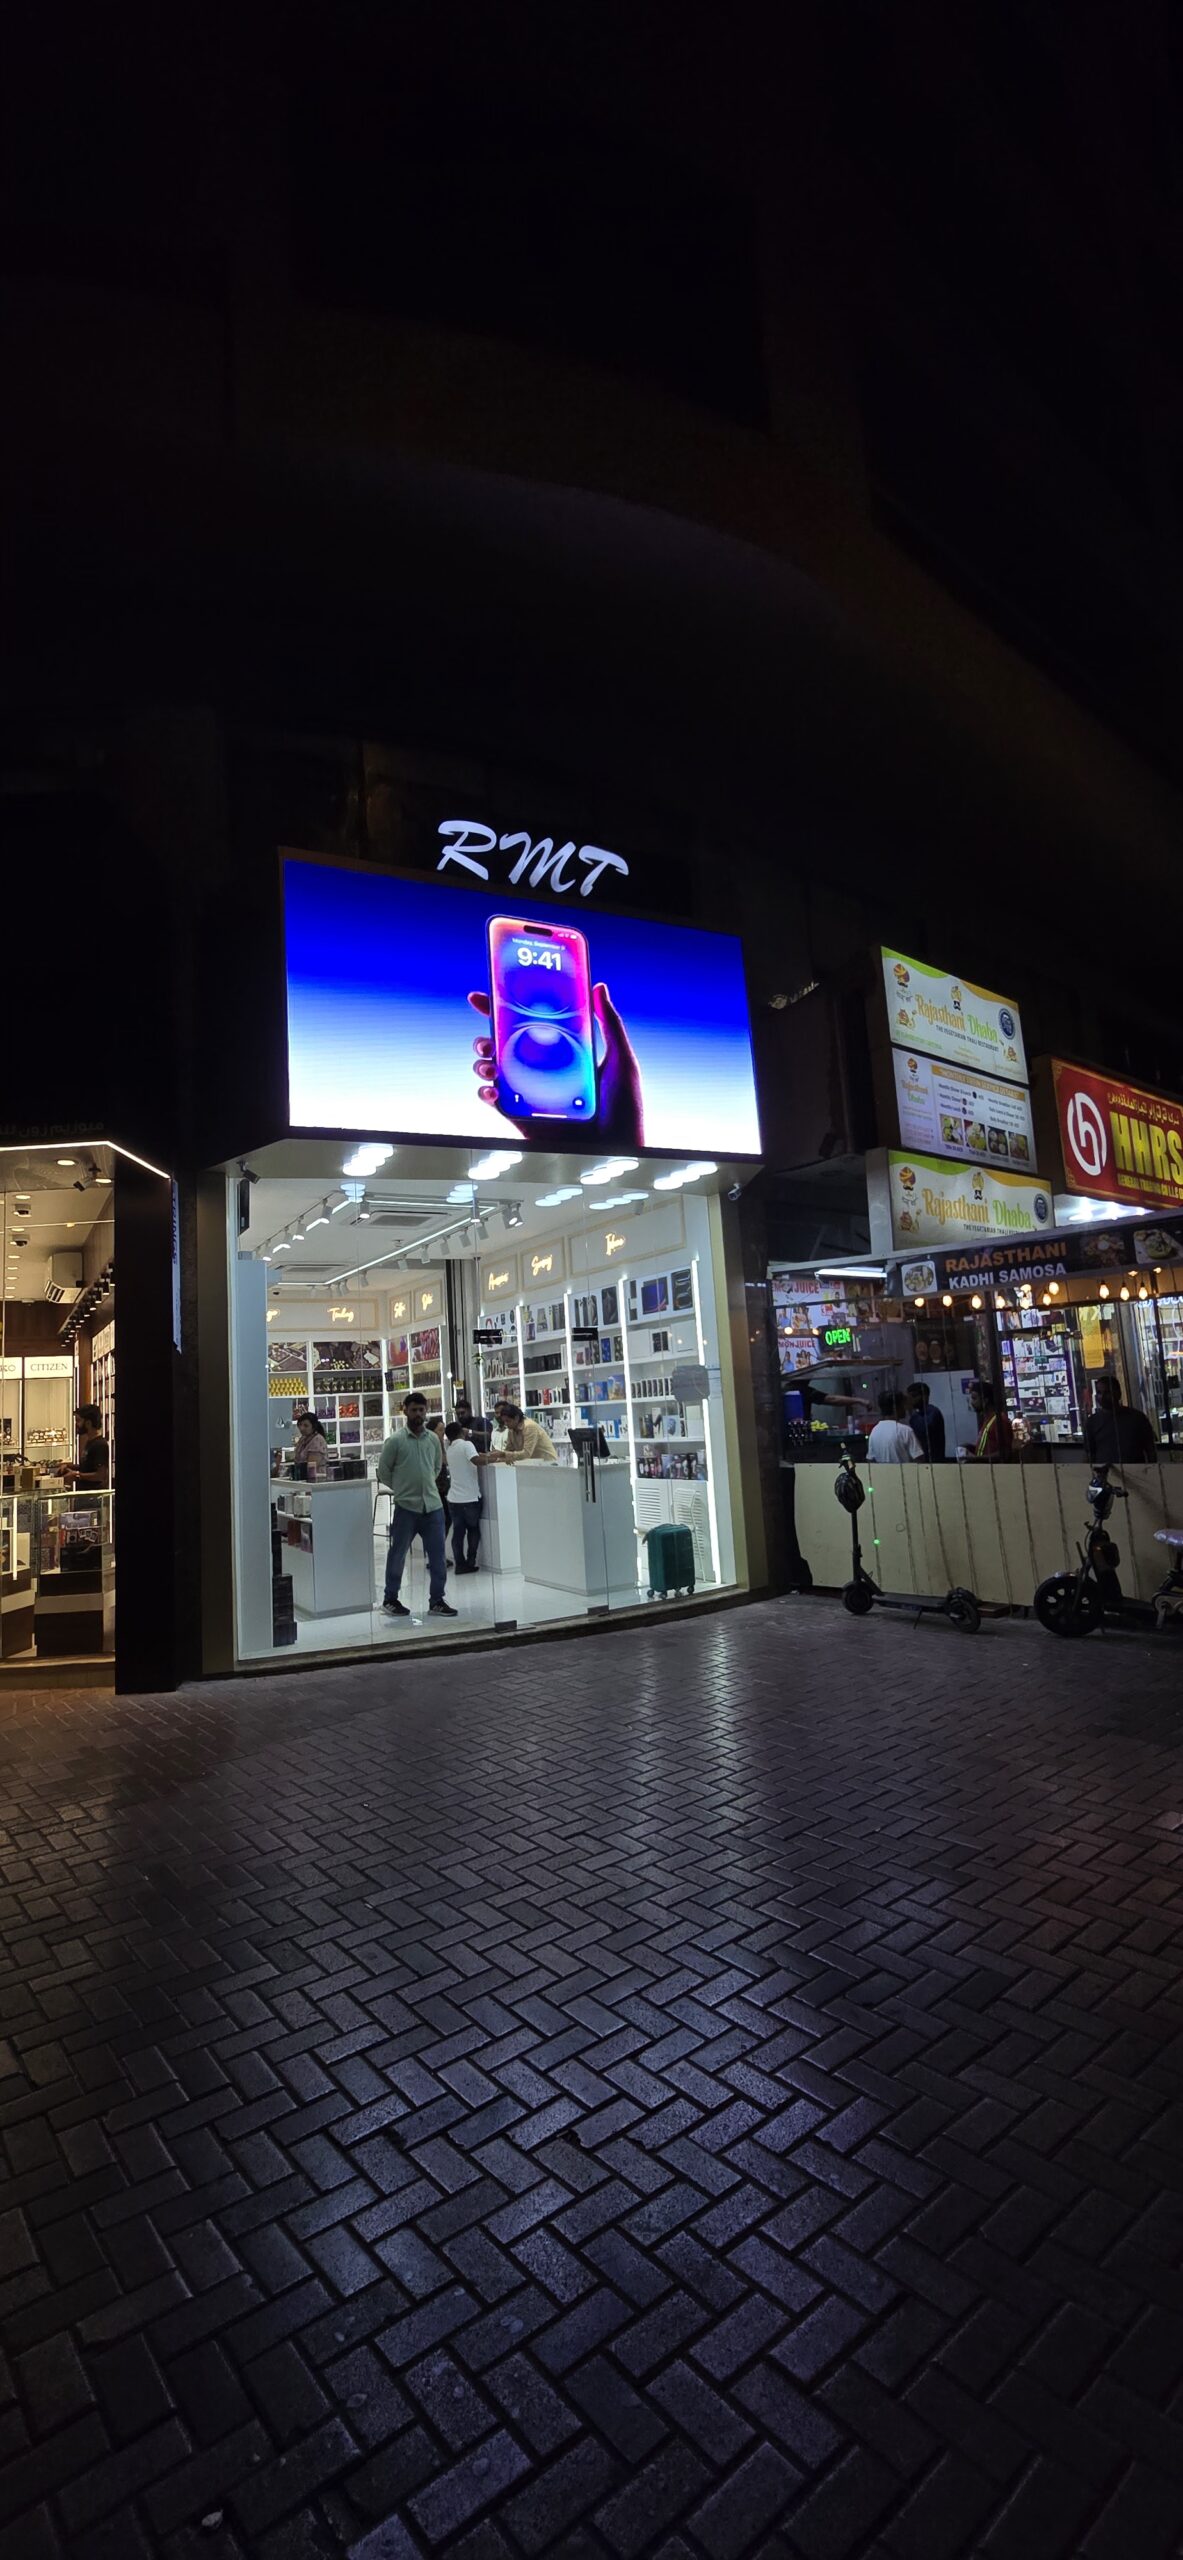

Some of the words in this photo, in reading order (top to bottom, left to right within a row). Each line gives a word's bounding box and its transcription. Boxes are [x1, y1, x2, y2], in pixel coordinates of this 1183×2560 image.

[437, 820, 629, 896] RMT
[517, 947, 561, 971] 9:41
[914, 993, 966, 1032] Rajasthani
[967, 1014, 998, 1043] Dhaba
[1110, 1111, 1183, 1186] HHRS
[922, 1188, 989, 1226] Rajasthani
[992, 1200, 1032, 1229] Dhaba
[946, 1241, 1067, 1273] RAJASTHANI
[794, 1281, 820, 1294] JUICE
[949, 1272, 994, 1290] KADHI
[999, 1263, 1066, 1284] SAMOSA
[795, 1340, 816, 1348] JUICE
[825, 1327, 851, 1345] OPEN
[30, 1362, 68, 1372] CITIZEN
